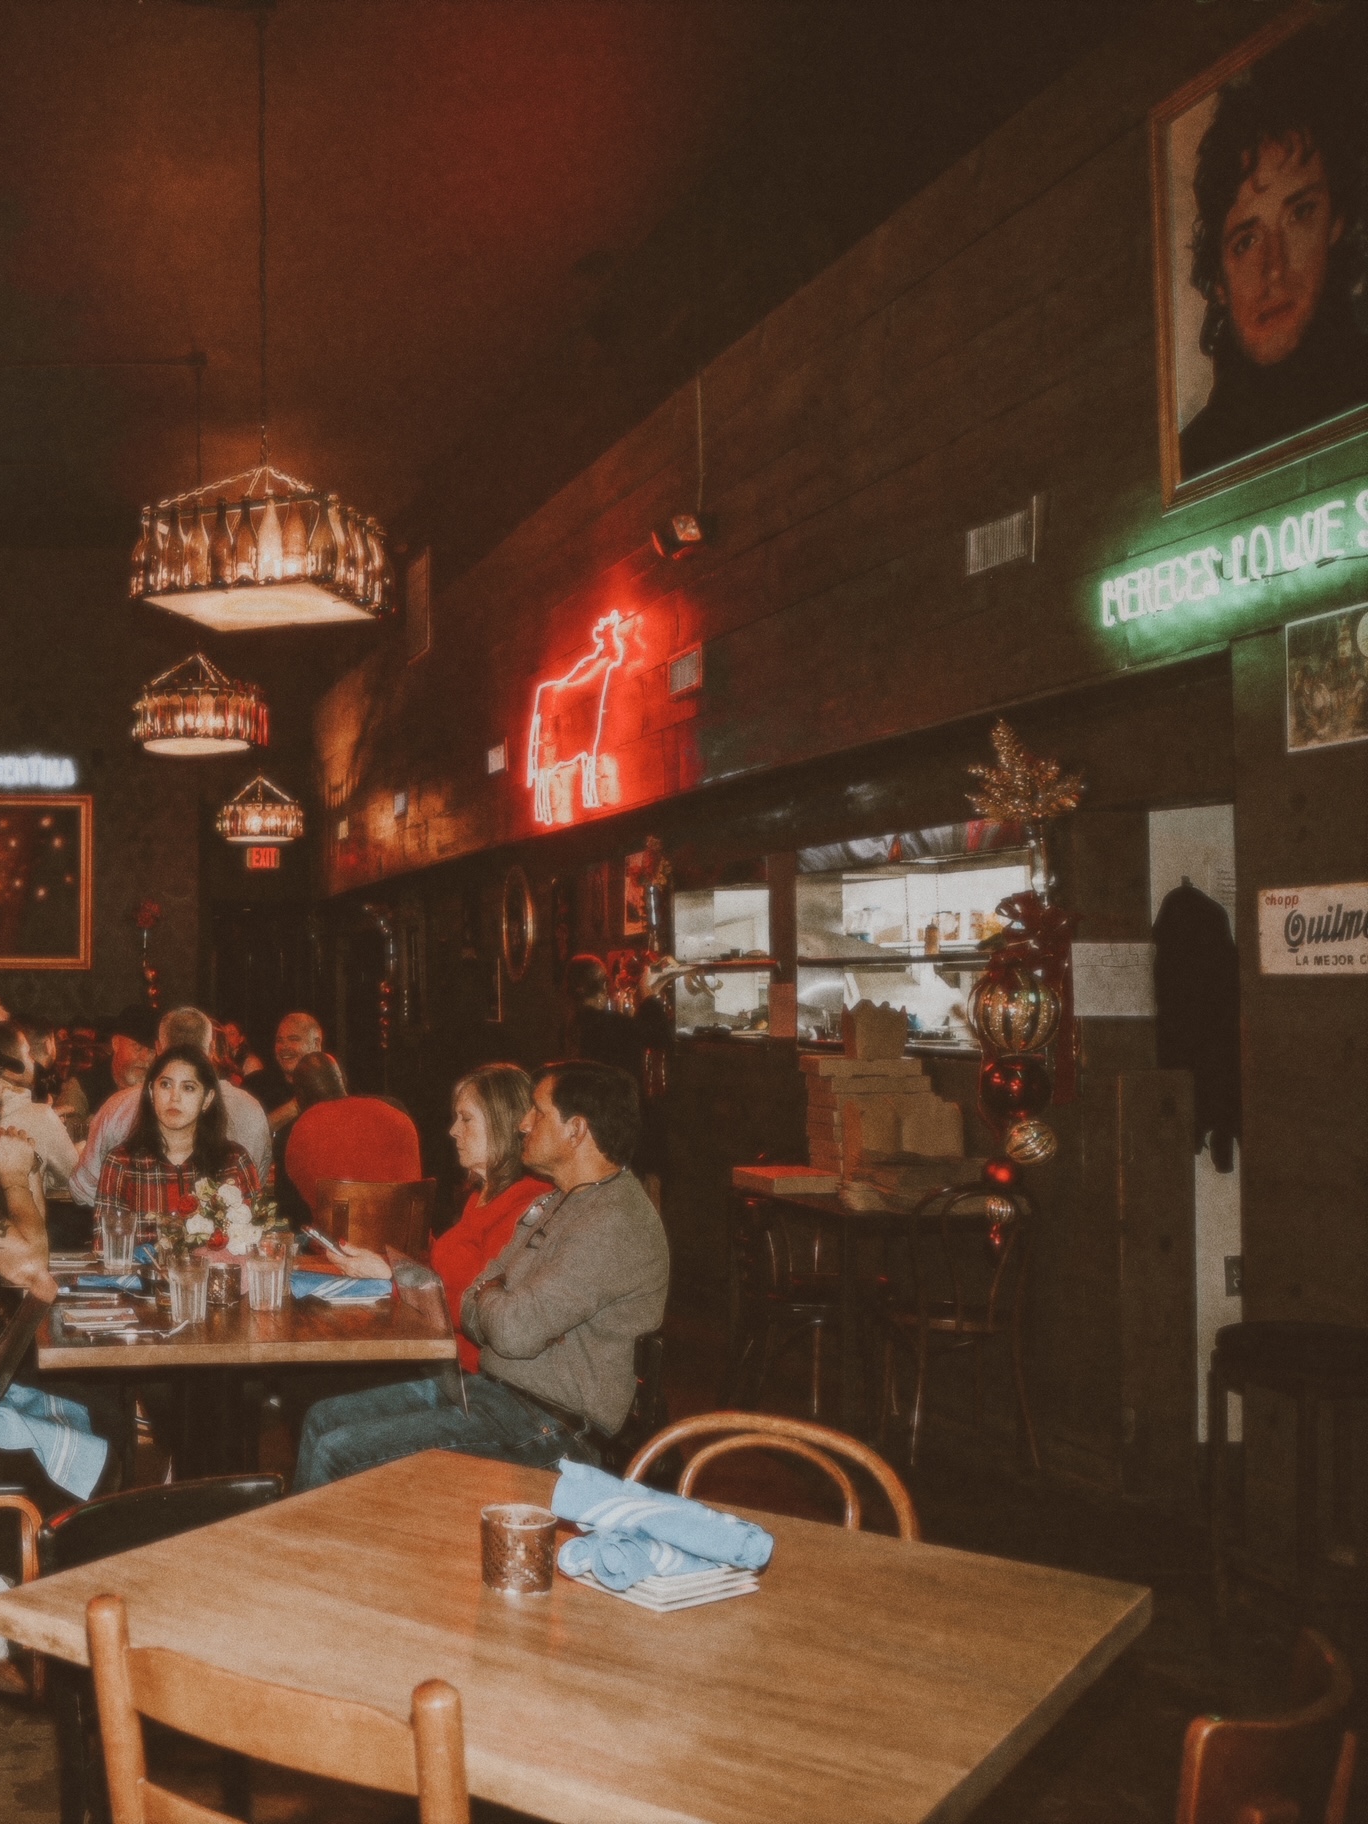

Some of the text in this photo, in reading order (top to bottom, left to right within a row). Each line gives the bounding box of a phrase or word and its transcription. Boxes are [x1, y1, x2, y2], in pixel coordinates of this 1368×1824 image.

[1101, 546, 1223, 628] MERECES
[1231, 524, 1275, 586] LO
[1279, 499, 1346, 571] QUE
[252, 848, 278, 868] EXIT
[1265, 894, 1300, 909] chopp
[1295, 955, 1309, 966] LA
[1313, 954, 1354, 967] MEJOR
